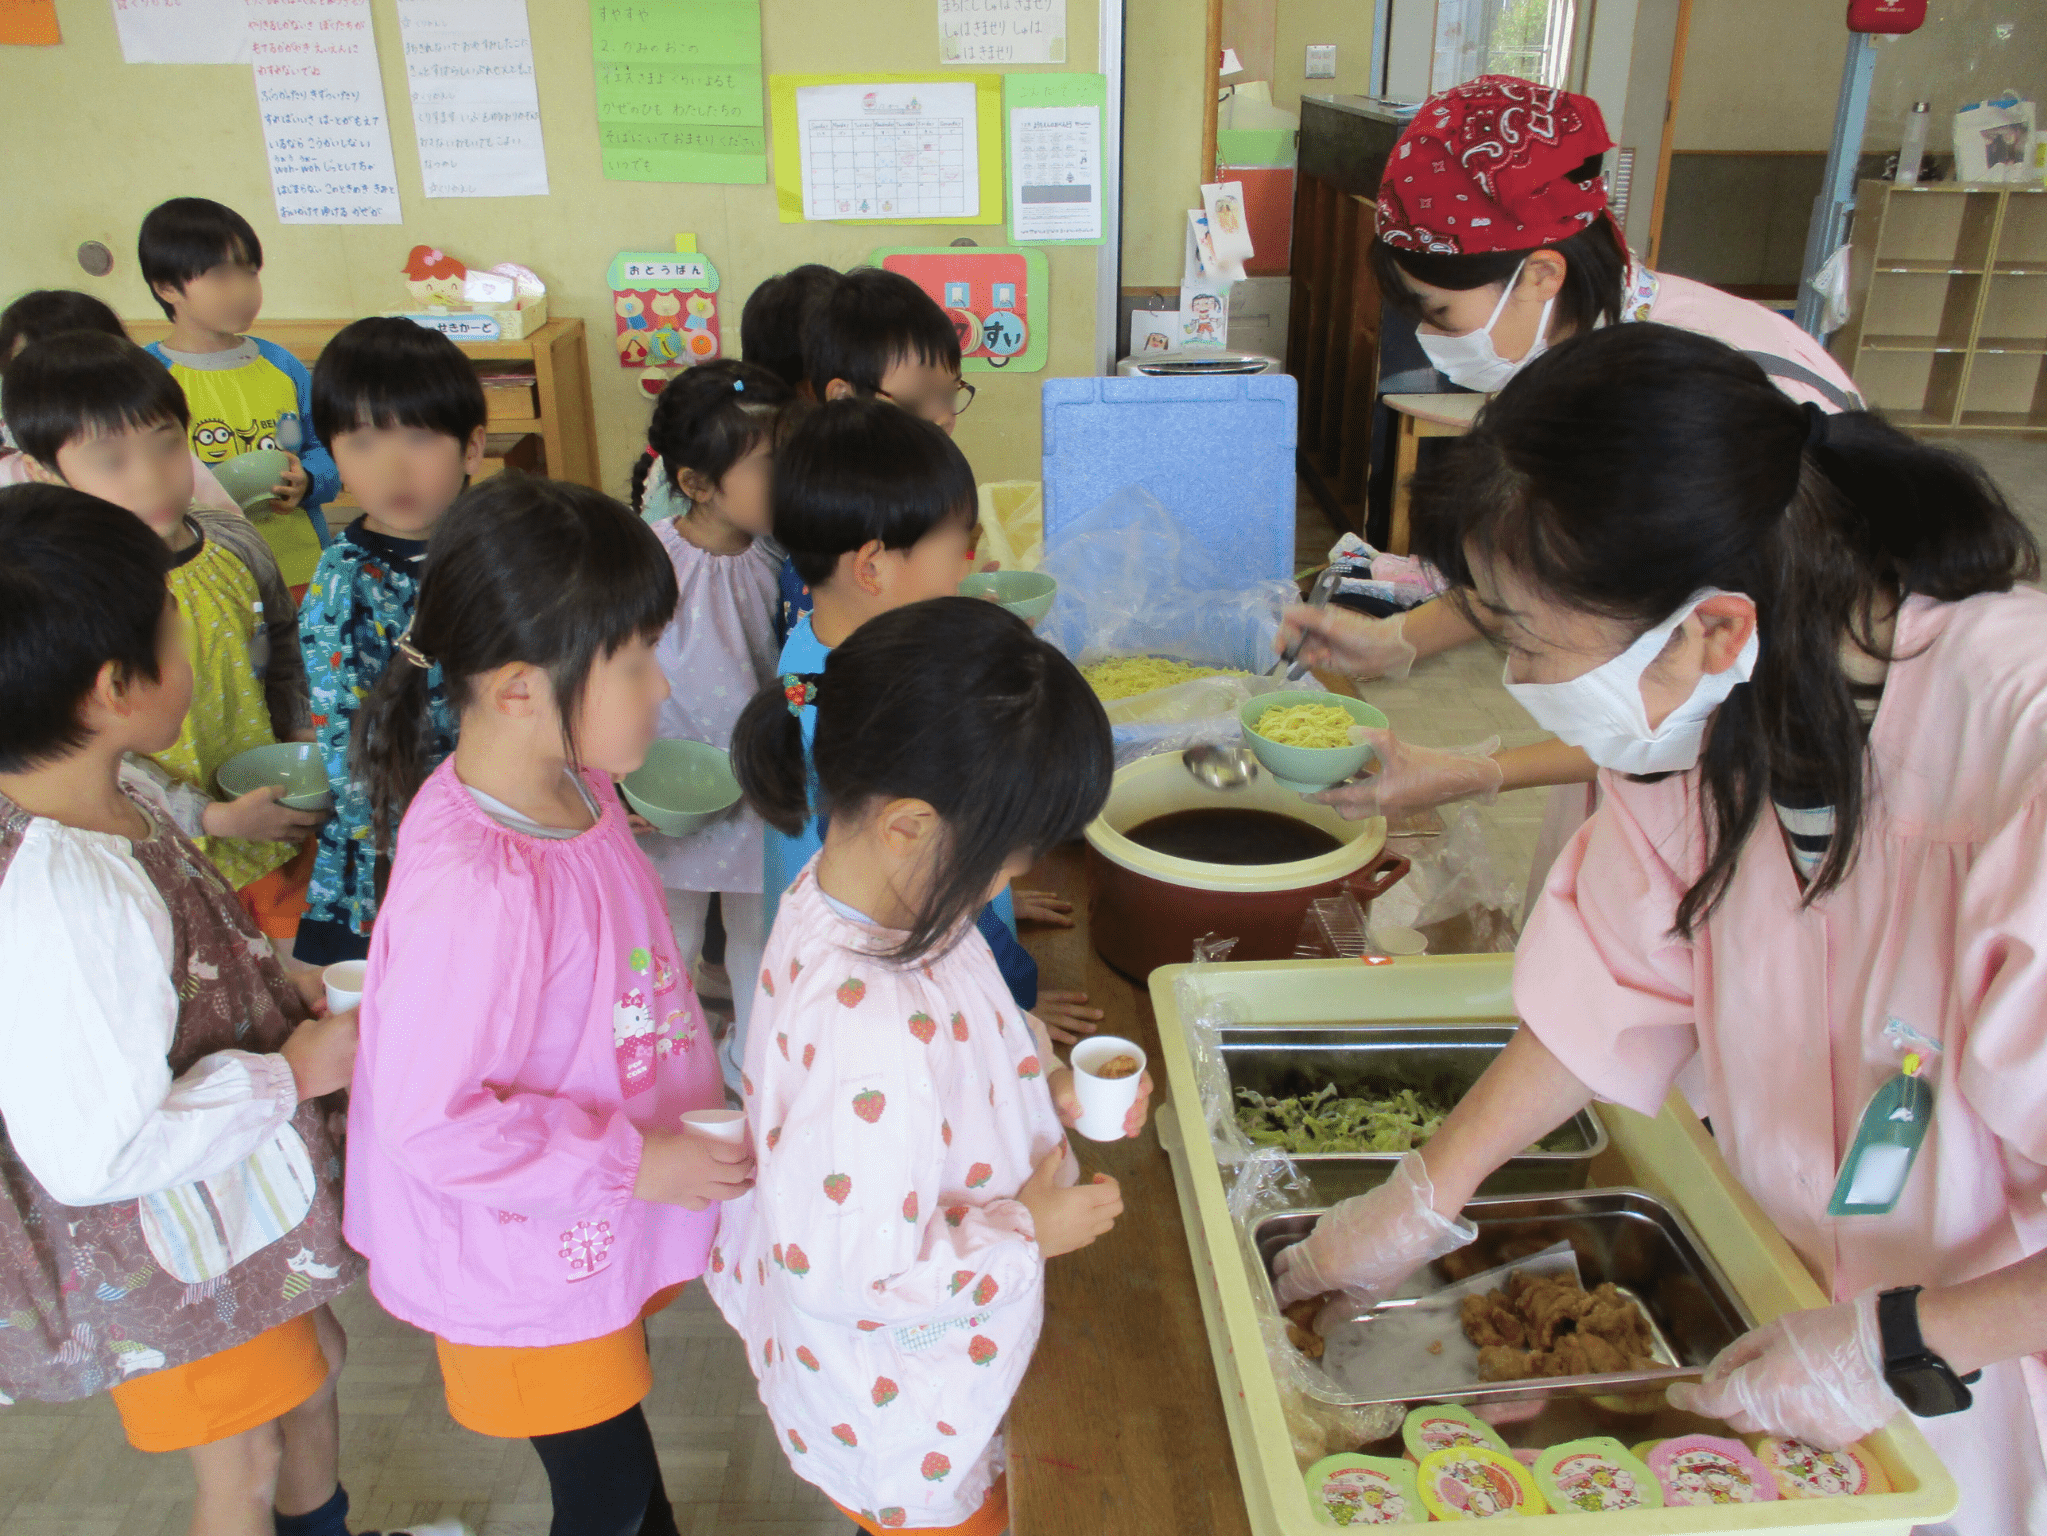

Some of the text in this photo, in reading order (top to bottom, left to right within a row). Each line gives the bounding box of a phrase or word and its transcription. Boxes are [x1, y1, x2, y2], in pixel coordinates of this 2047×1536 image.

[629, 264, 702, 276] おとうばん
[984, 321, 1021, 349] すい
